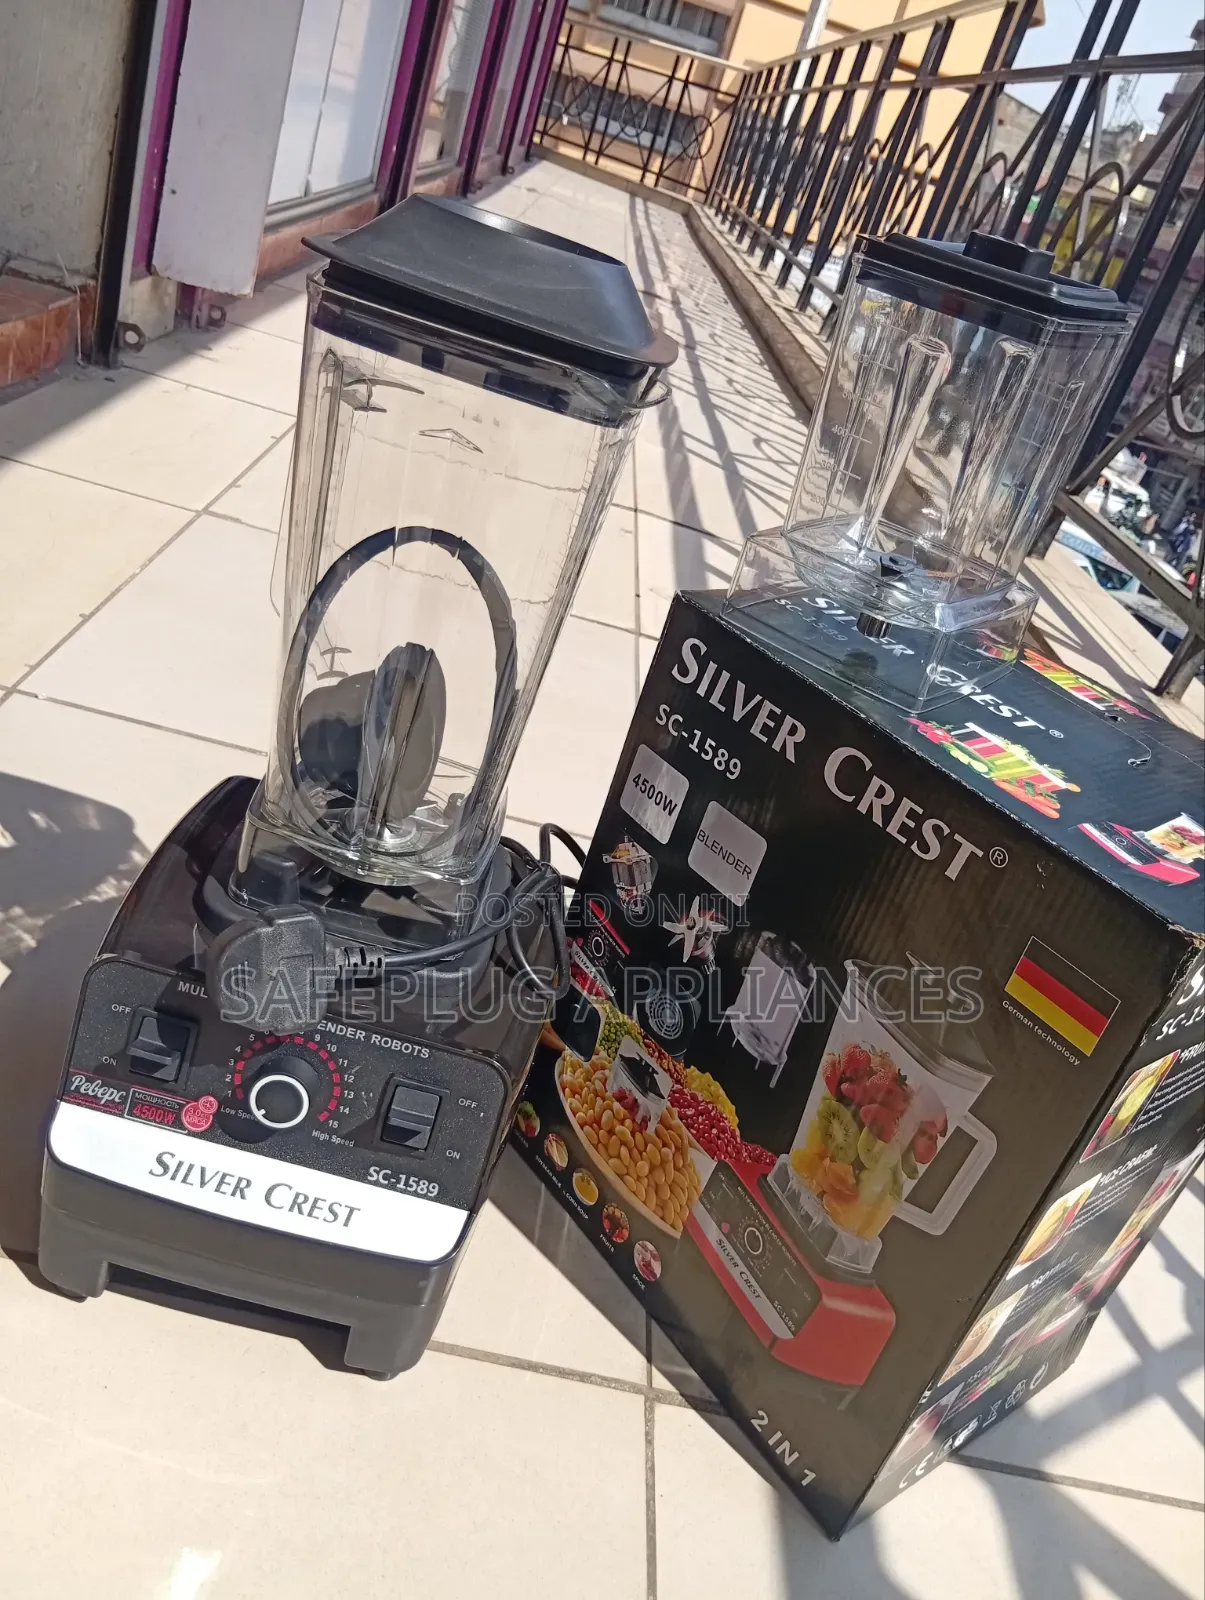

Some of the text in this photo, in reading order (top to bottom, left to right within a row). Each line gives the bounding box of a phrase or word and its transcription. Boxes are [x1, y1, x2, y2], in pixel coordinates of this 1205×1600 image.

[774, 599, 849, 641] SC-1589
[801, 596, 915, 656] SILER
[655, 703, 742, 780] SC-1589
[671, 637, 806, 764] SILVER
[823, 746, 984, 881] CREST
[632, 773, 678, 817] 4500W
[696, 829, 753, 880] BLENDER
[111, 1003, 132, 1014] OFF
[314, 1034, 321, 1042] 9
[1002, 1000, 1081, 1065] German technology
[326, 1043, 337, 1052] 10
[371, 1033, 430, 1059] ROBOTS
[102, 1055, 117, 1066] ON
[338, 1058, 348, 1067] 11
[344, 1074, 355, 1083] 12
[70, 1075, 126, 1105] Реверс
[134, 1092, 180, 1109] МОЩНОСТЬ
[343, 1090, 354, 1098] 13
[132, 1103, 176, 1125] 4500W
[220, 1105, 258, 1122] Low Spee
[339, 1105, 350, 1114] 14
[458, 1097, 478, 1109] OFF
[328, 1119, 339, 1129] 15
[312, 1129, 355, 1147] High Speed
[446, 1149, 461, 1159] ON
[148, 1151, 362, 1228] SILVER CREST
[367, 1166, 439, 1197] SC-1589
[716, 1238, 739, 1268] SILVER
[739, 1270, 763, 1300] CREST
[773, 1300, 797, 1332] SC-1589
[750, 1409, 817, 1487] 2 IN 1
